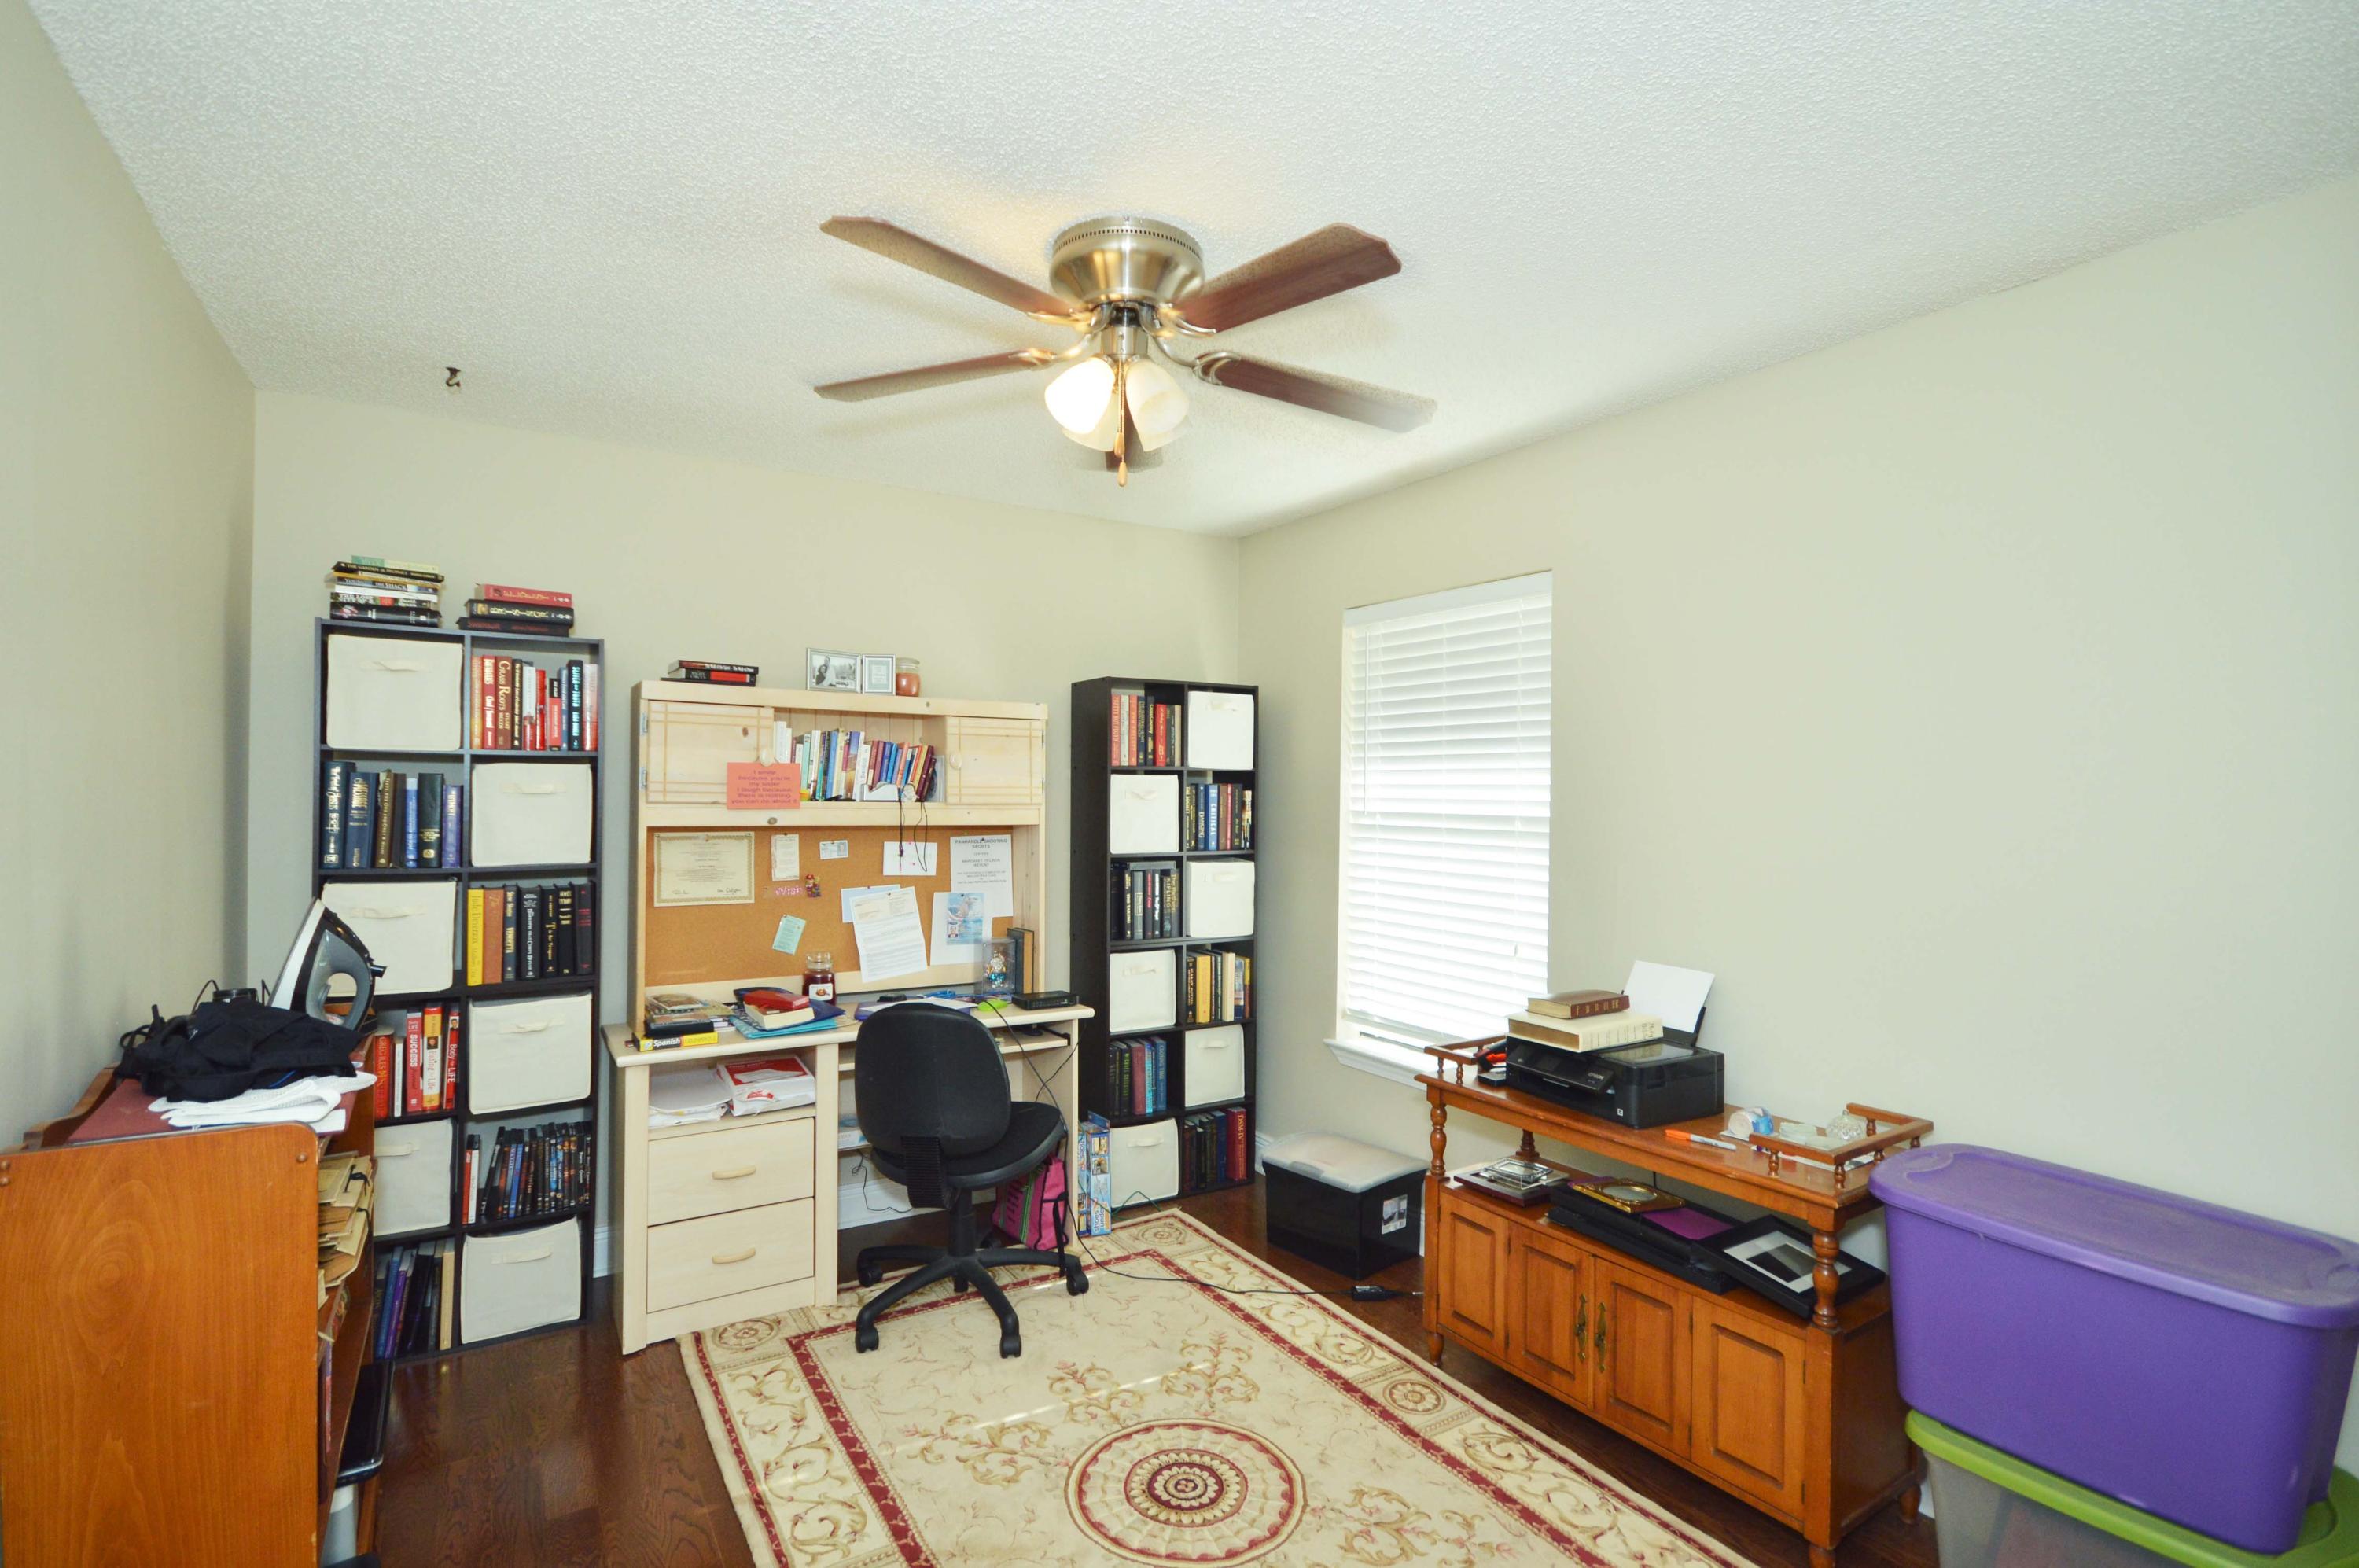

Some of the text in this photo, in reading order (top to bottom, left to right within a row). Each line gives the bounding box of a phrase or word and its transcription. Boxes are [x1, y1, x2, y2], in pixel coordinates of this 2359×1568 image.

[385, 583, 407, 591] SHACK
[572, 667, 580, 684] SLIVER
[498, 661, 511, 711] GRASS ROOTS
[572, 691, 580, 707] TRUTH
[447, 794, 457, 816] UTMOST
[471, 895, 482, 944] Jude Deveraux
[505, 927, 516, 954] VENDETTA
[378, 1036, 388, 1055] GREG
[410, 1034, 418, 1067] SUCCESS
[653, 1036, 680, 1048] Spanish
[448, 1043, 458, 1059] Body
[378, 1055, 387, 1069] ILES
[427, 1077, 436, 1091] Life
[447, 1067, 456, 1084] LIFE
